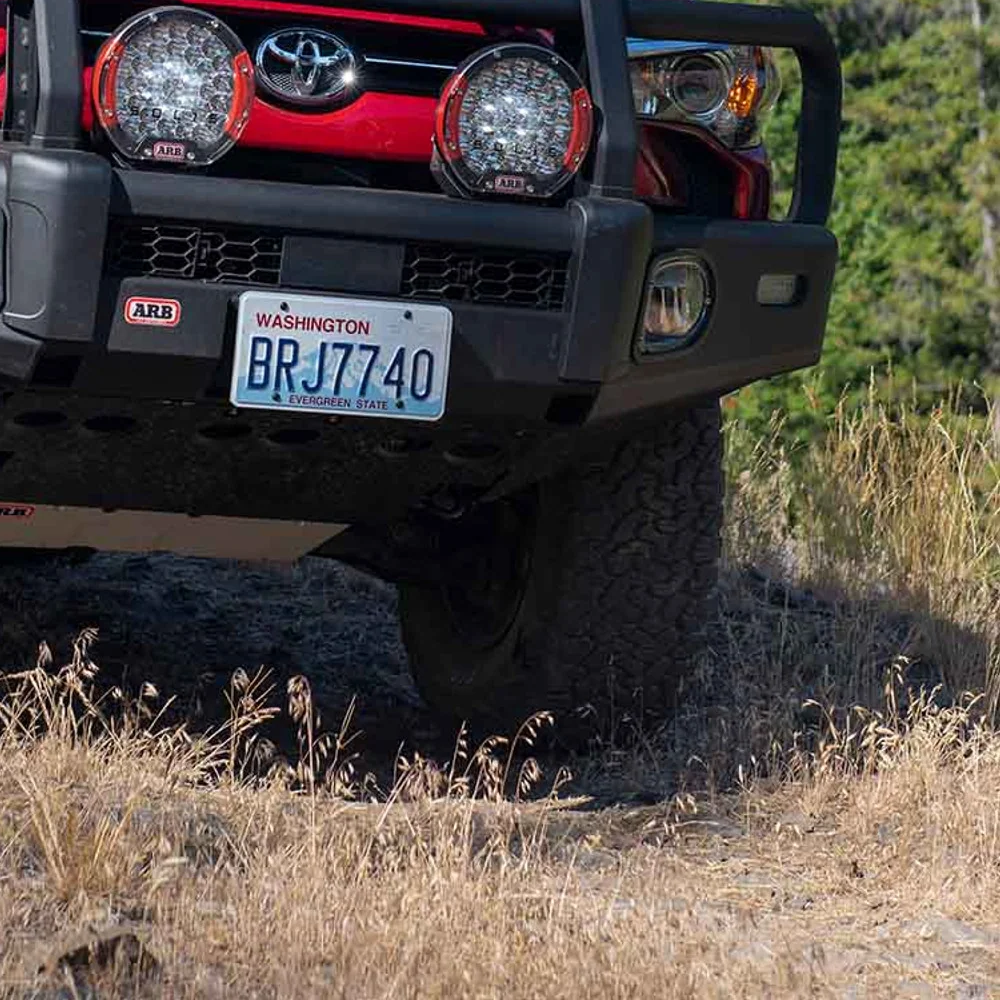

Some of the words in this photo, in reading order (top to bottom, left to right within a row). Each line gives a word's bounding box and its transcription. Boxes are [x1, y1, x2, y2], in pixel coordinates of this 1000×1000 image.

[157, 145, 183, 156] ARB
[133, 303, 173, 319] ARB
[256, 312, 371, 336] WASHINGTON
[246, 336, 435, 401] BRJ7740
[288, 394, 351, 409] EVERGREEN
[355, 398, 389, 410] STATE
